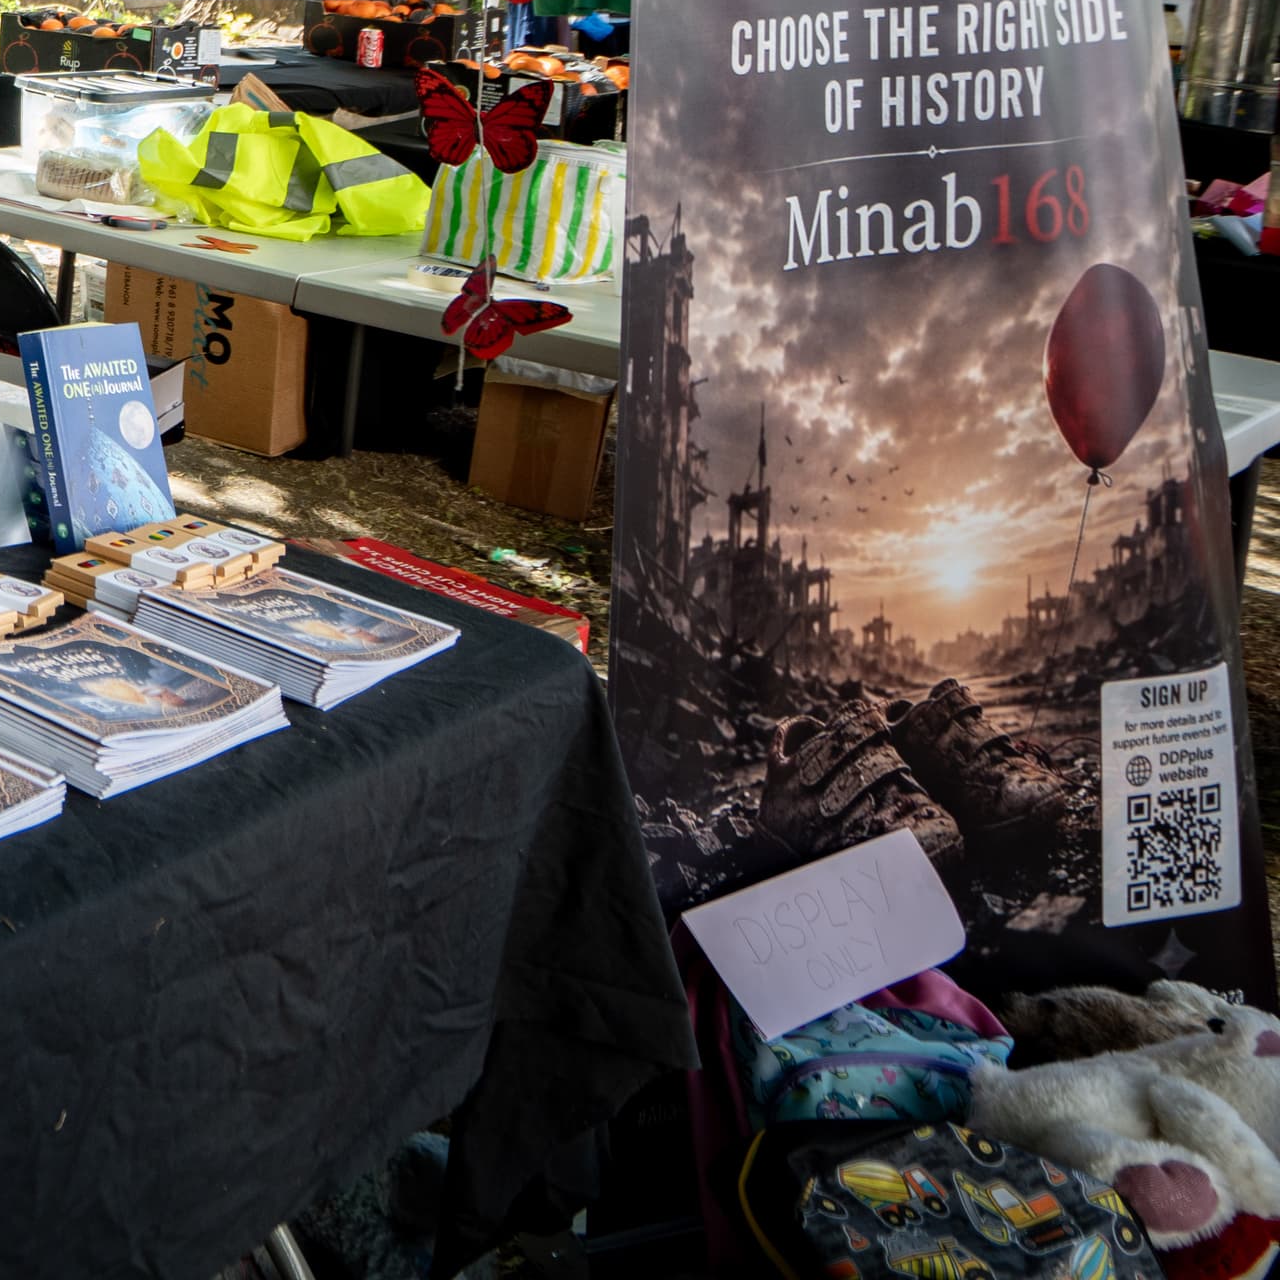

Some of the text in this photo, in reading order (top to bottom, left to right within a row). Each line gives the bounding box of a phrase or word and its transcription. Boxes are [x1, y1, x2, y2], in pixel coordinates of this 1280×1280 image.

[730, 10, 850, 76] CHOOSE
[863, 4, 941, 61] THE
[824, 65, 1046, 134] OF HISTORY
[83, 358, 138, 379] AWAITED
[32, 381, 49, 431] AWAITED
[382, 556, 431, 575] CHIPS
[362, 556, 514, 617] SUPERCRUNCH
[430, 575, 467, 590] CUT
[1140, 679, 1209, 709] SIGN UP
[1124, 720, 1138, 733] for
[1140, 719, 1165, 732] more
[1166, 713, 1197, 729] details
[1198, 711, 1214, 723] and
[1112, 728, 1211, 751] support future events
[1159, 746, 1214, 767] DDPplus
[1159, 766, 1209, 784] website
[732, 855, 891, 965] DISPLAY
[806, 927, 889, 990] ONLY
